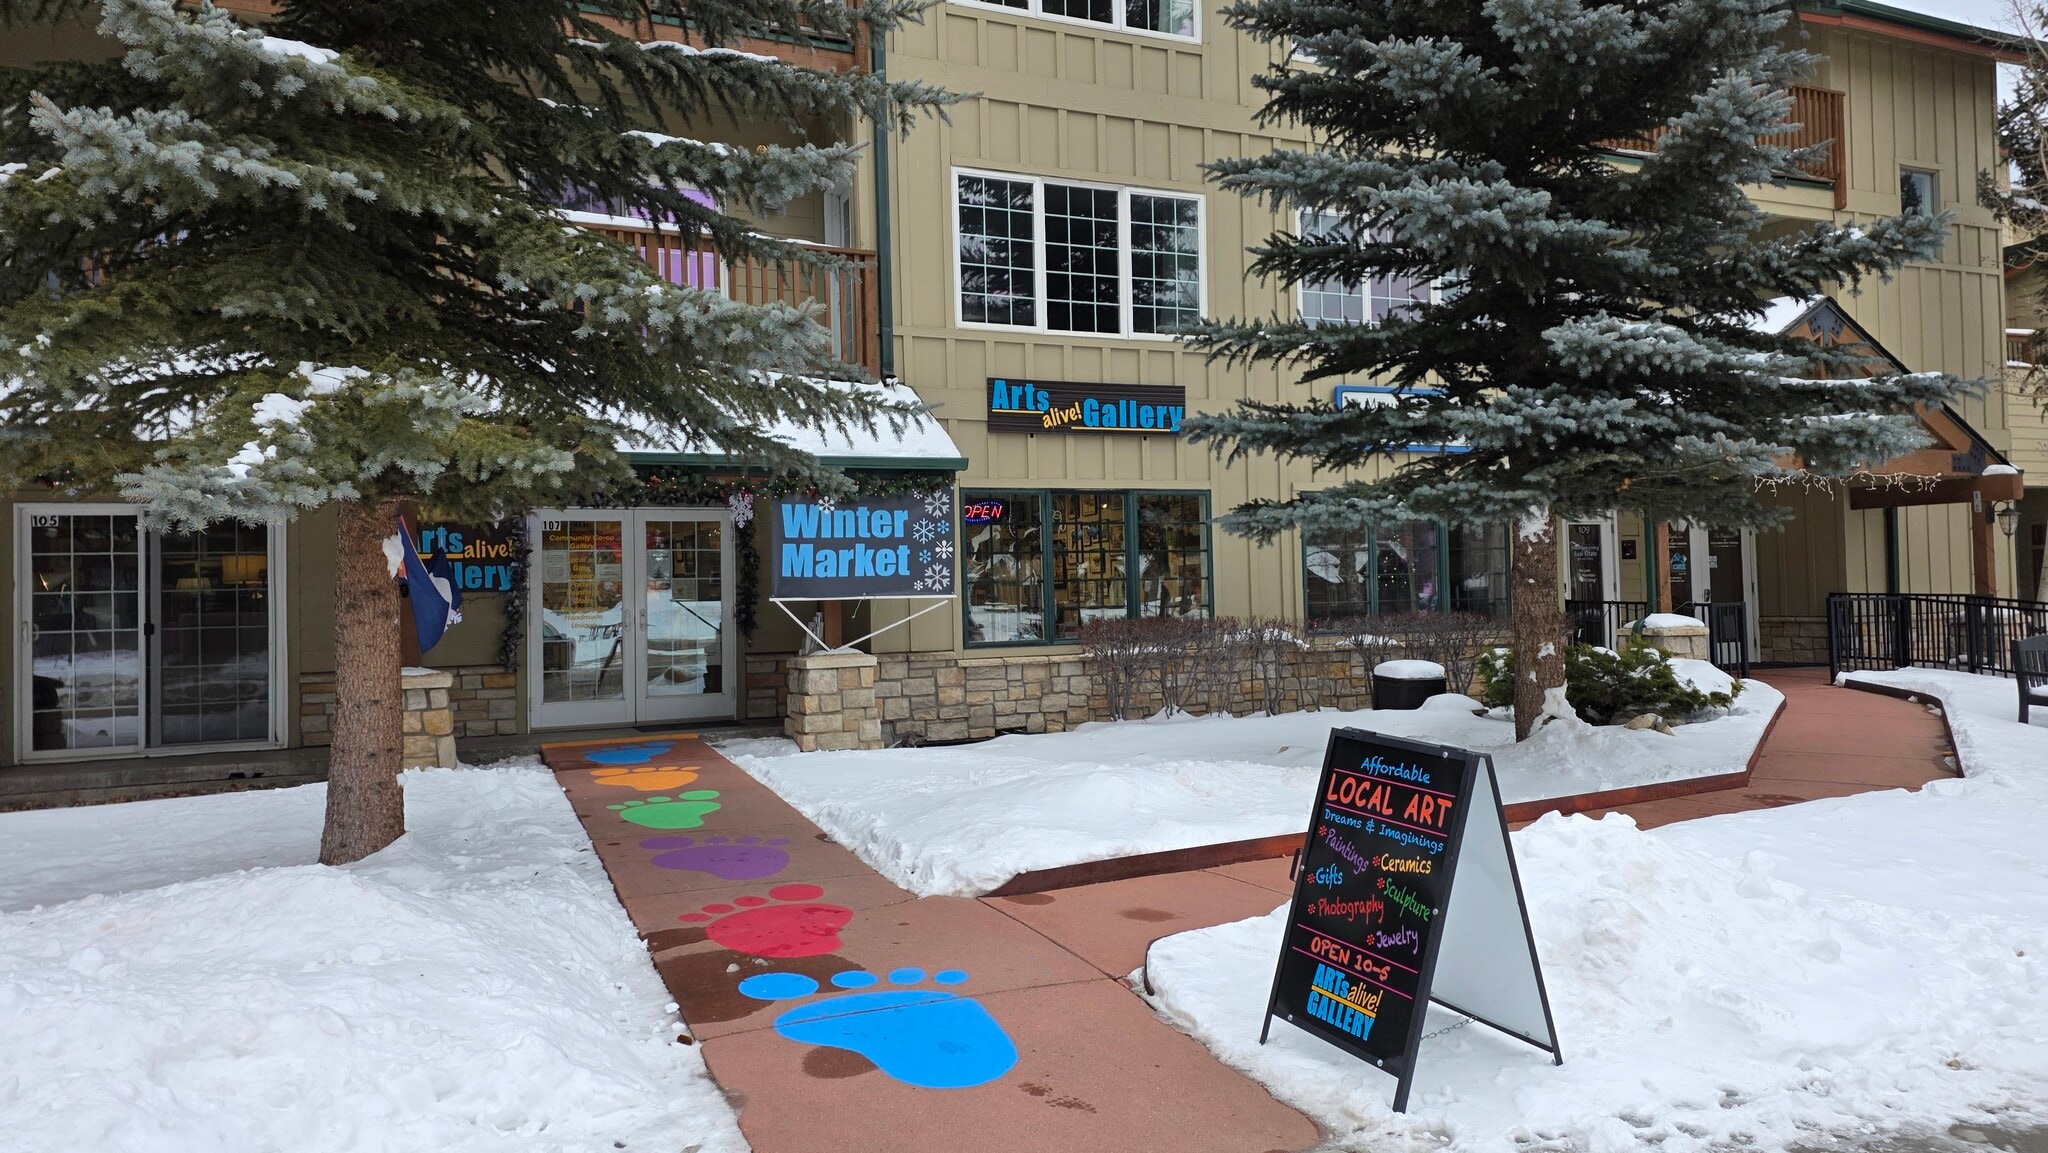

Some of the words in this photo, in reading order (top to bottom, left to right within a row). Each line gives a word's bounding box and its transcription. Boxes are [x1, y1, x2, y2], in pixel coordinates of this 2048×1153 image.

[992, 380, 1049, 411] Arts
[1043, 402, 1082, 429] alive!
[1083, 398, 1182, 432] Gallery
[33, 515, 57, 526] 105
[543, 520, 561, 531] 107
[782, 503, 909, 538] Winter
[1578, 526, 1591, 534] 109
[417, 526, 464, 553] rts
[464, 539, 513, 559] alive!
[549, 534, 591, 542] Community
[782, 543, 910, 577] Market
[564, 613, 604, 621] Handmade
[1361, 756, 1430, 784] Affordable
[1327, 773, 1393, 815] LOCAL
[1404, 793, 1453, 828] ART
[1324, 809, 1362, 829] Dreams
[1365, 819, 1375, 834] &
[1379, 824, 1444, 854] Imaginings
[1326, 828, 1369, 875] Paintings
[1381, 853, 1431, 875] Ceramics
[1316, 863, 1343, 890] Gifts
[1318, 894, 1384, 925] Photography
[1383, 878, 1431, 921] Sculpture
[1376, 924, 1419, 955] Jewelry
[1311, 936, 1350, 966] OPEN
[1354, 954, 1391, 981] 10-5
[1312, 963, 1350, 999] ARTs
[1346, 981, 1384, 1012] alive!
[1306, 991, 1375, 1041] GALLERY
